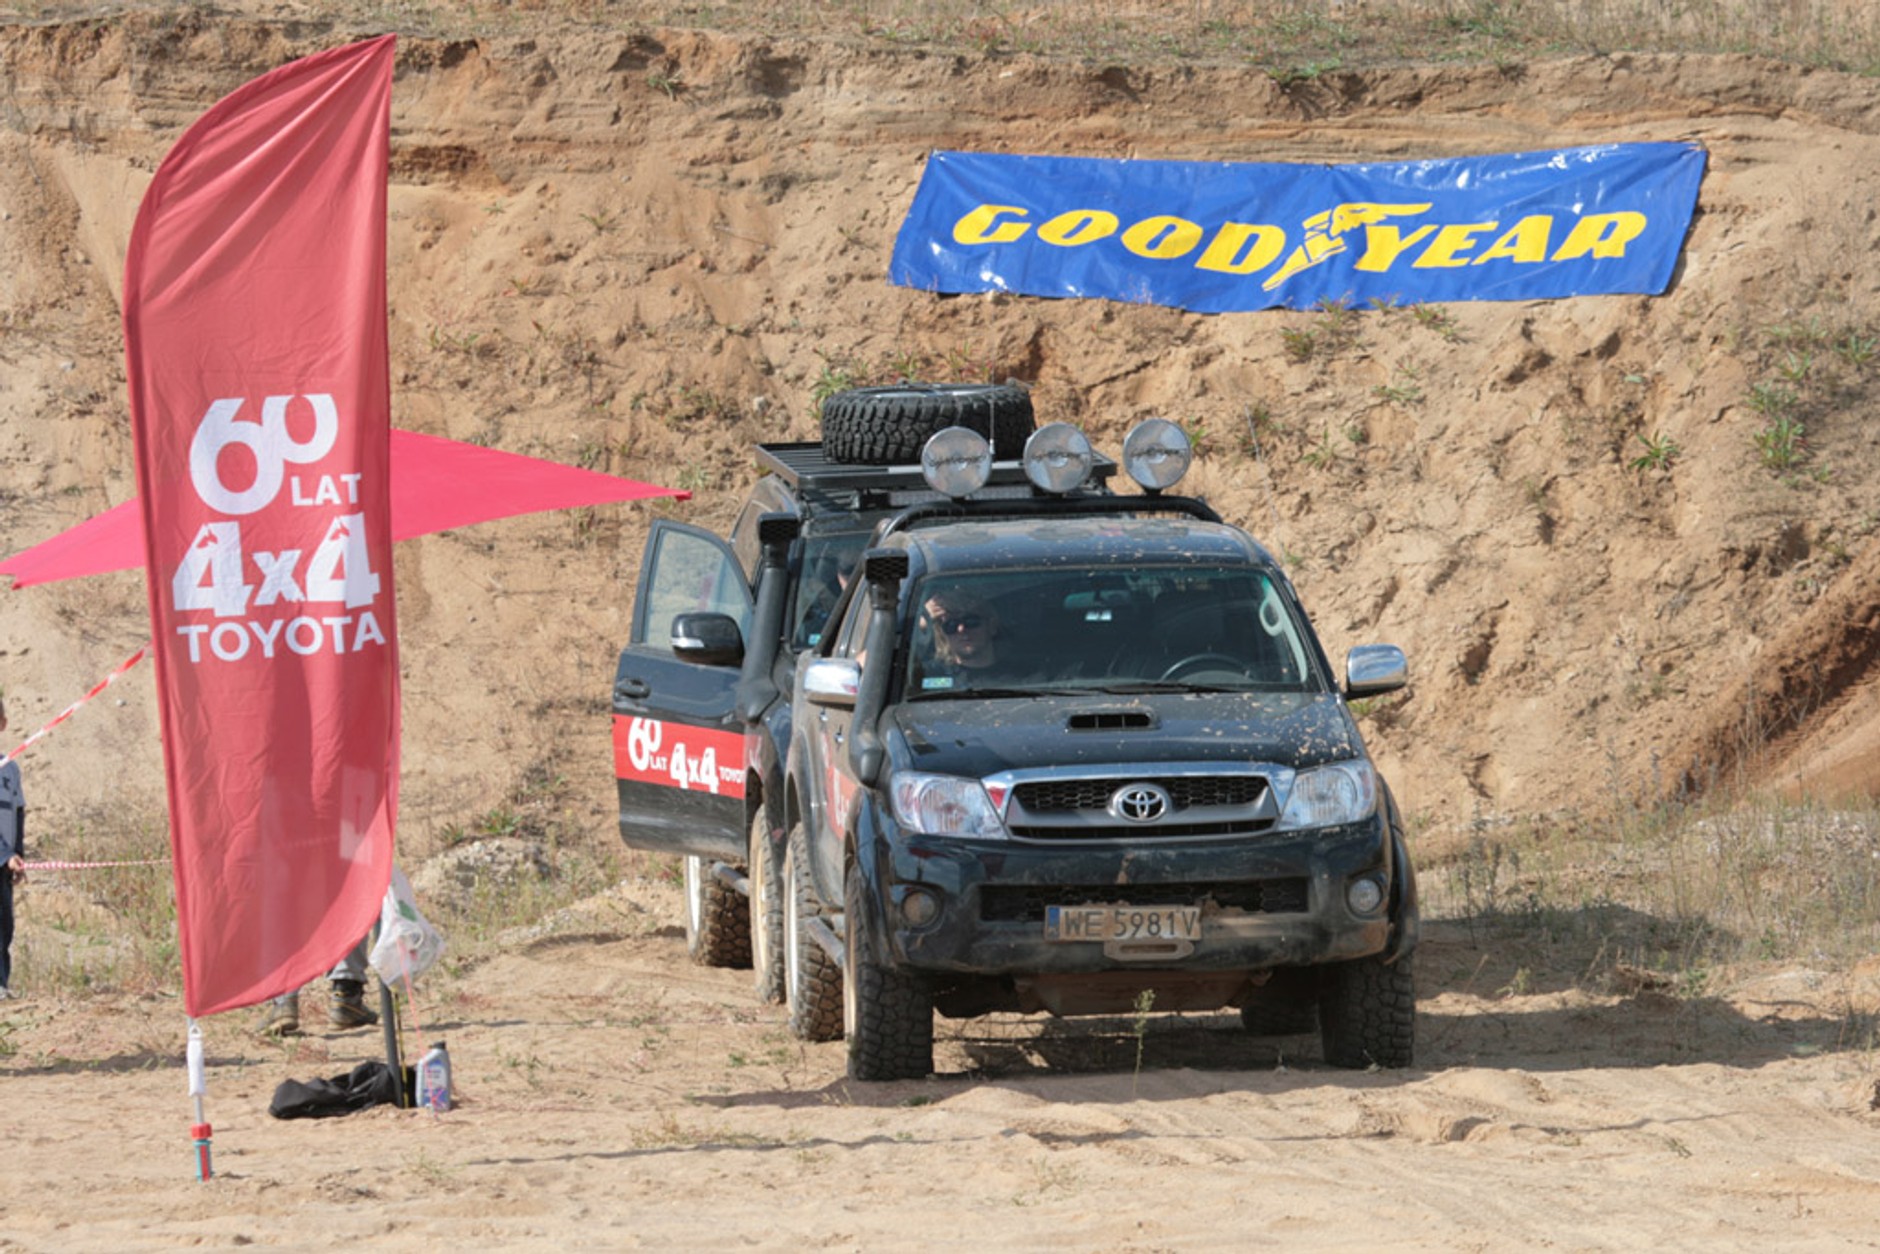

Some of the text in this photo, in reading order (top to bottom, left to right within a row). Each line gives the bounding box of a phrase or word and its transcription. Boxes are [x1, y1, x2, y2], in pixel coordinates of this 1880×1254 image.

[189, 393, 362, 515] 60 LAT
[172, 512, 381, 618] 4x4
[176, 611, 386, 663] TOYOTA
[628, 716, 662, 771] 60
[670, 742, 719, 794] 4x4
[1064, 910, 1196, 938] WE 5981V
